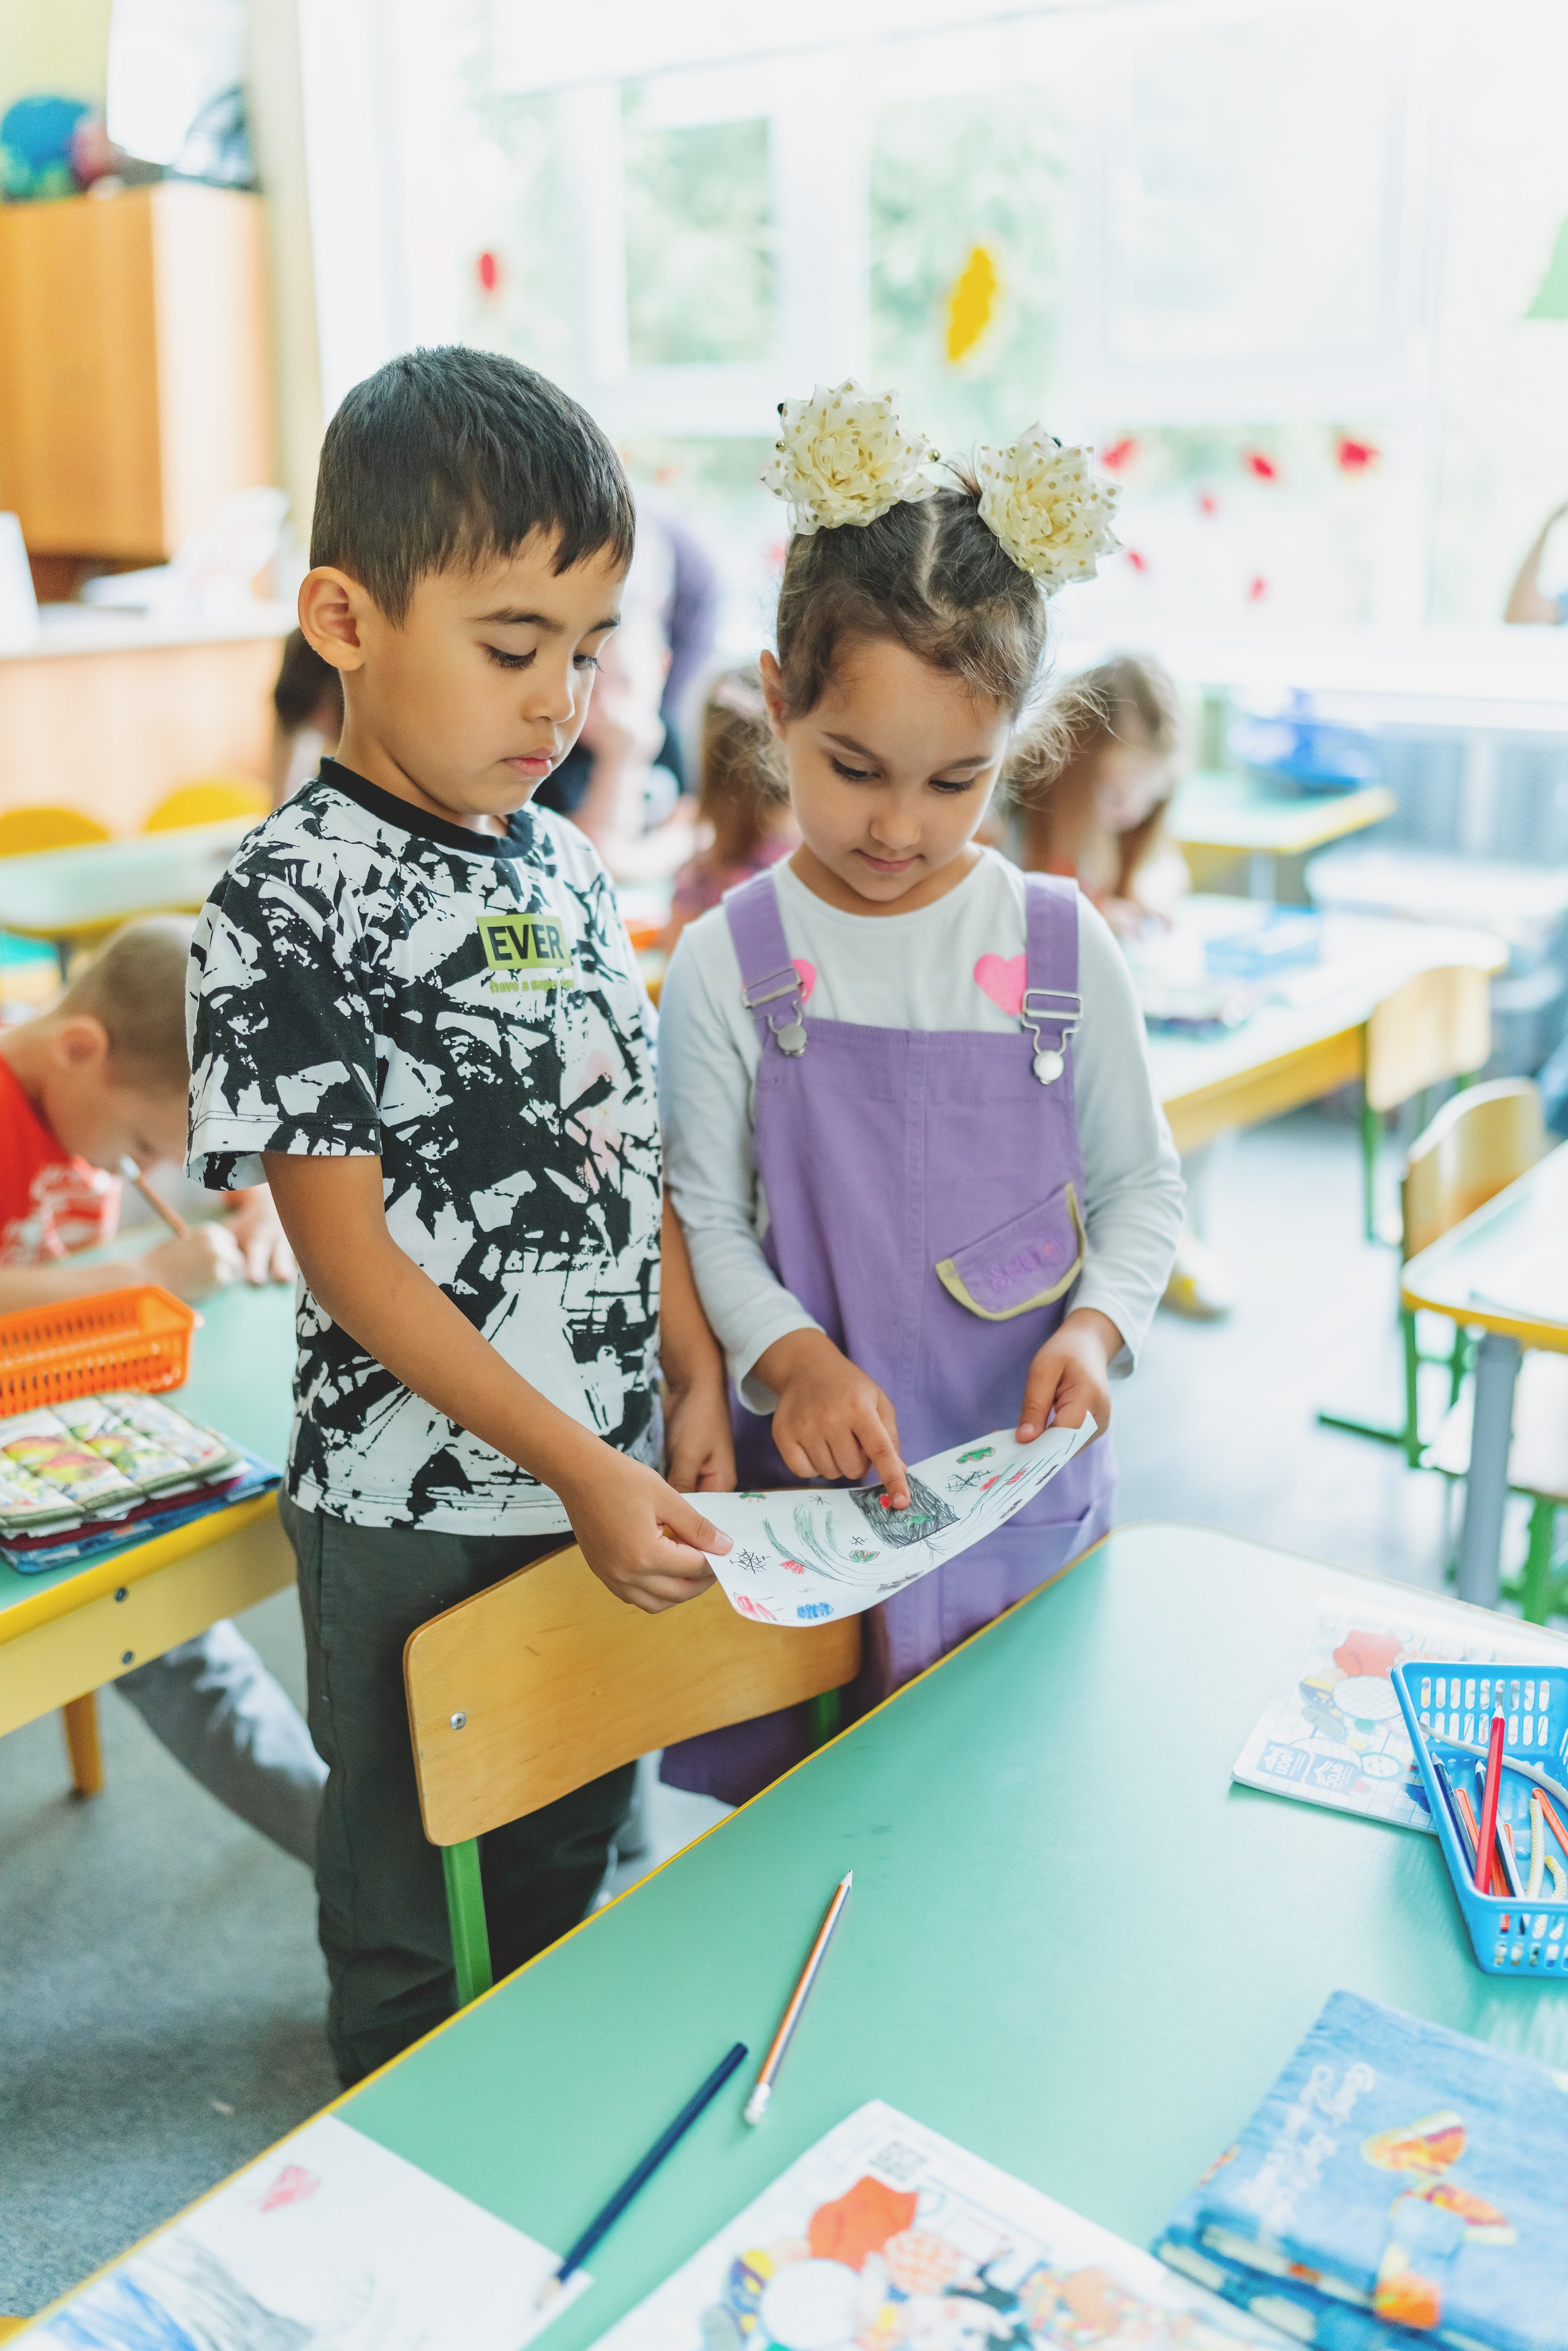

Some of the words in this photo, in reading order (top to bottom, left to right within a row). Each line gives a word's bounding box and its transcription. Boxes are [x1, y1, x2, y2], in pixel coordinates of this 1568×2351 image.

[487, 924, 564, 961] EVER
[490, 979, 519, 994] have
[521, 981, 529, 992] a
[1324, 1763, 1344, 1788] ФГОС
